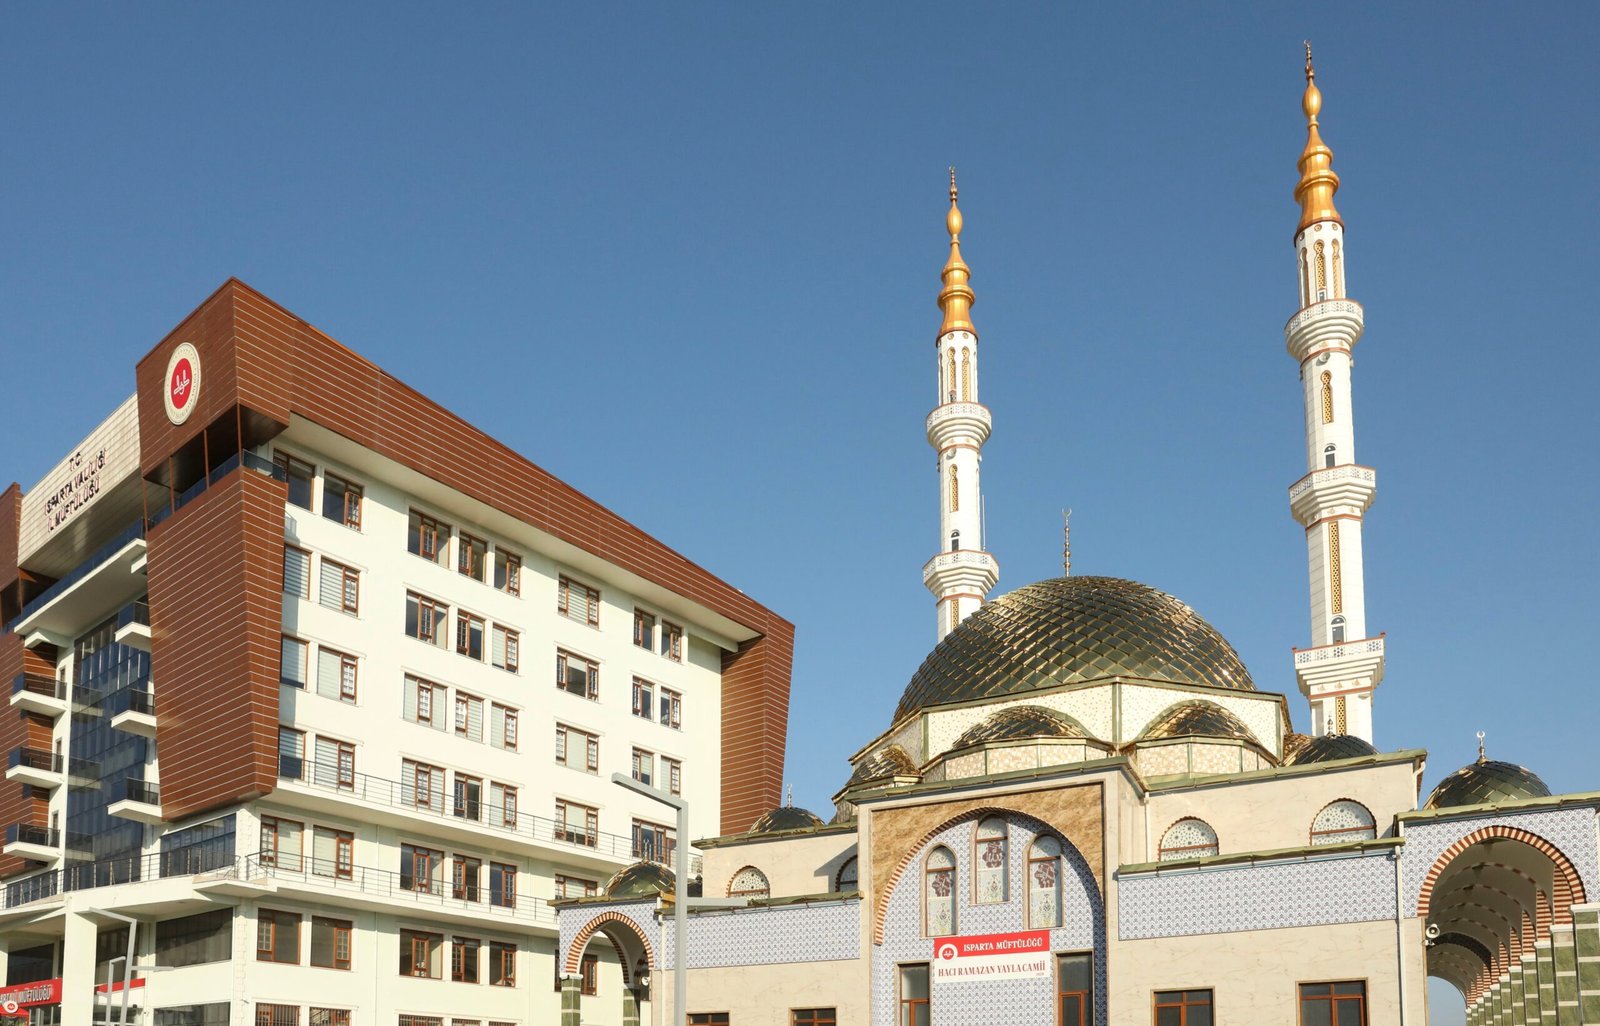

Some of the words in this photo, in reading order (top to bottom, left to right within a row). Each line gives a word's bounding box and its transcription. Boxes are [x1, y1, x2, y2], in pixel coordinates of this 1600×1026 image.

[45, 481, 73, 516] ISPARTA
[55, 475, 100, 527] MÜFTÜLÜĞÜ
[963, 942, 994, 952] ISPARTA
[995, 937, 1043, 950] MÜFTÜLÜĞÜ
[938, 968, 957, 977] HACI
[958, 965, 995, 976] RAMAZAN
[997, 963, 1021, 974] YAYLA
[1022, 960, 1046, 972] CAMİİ
